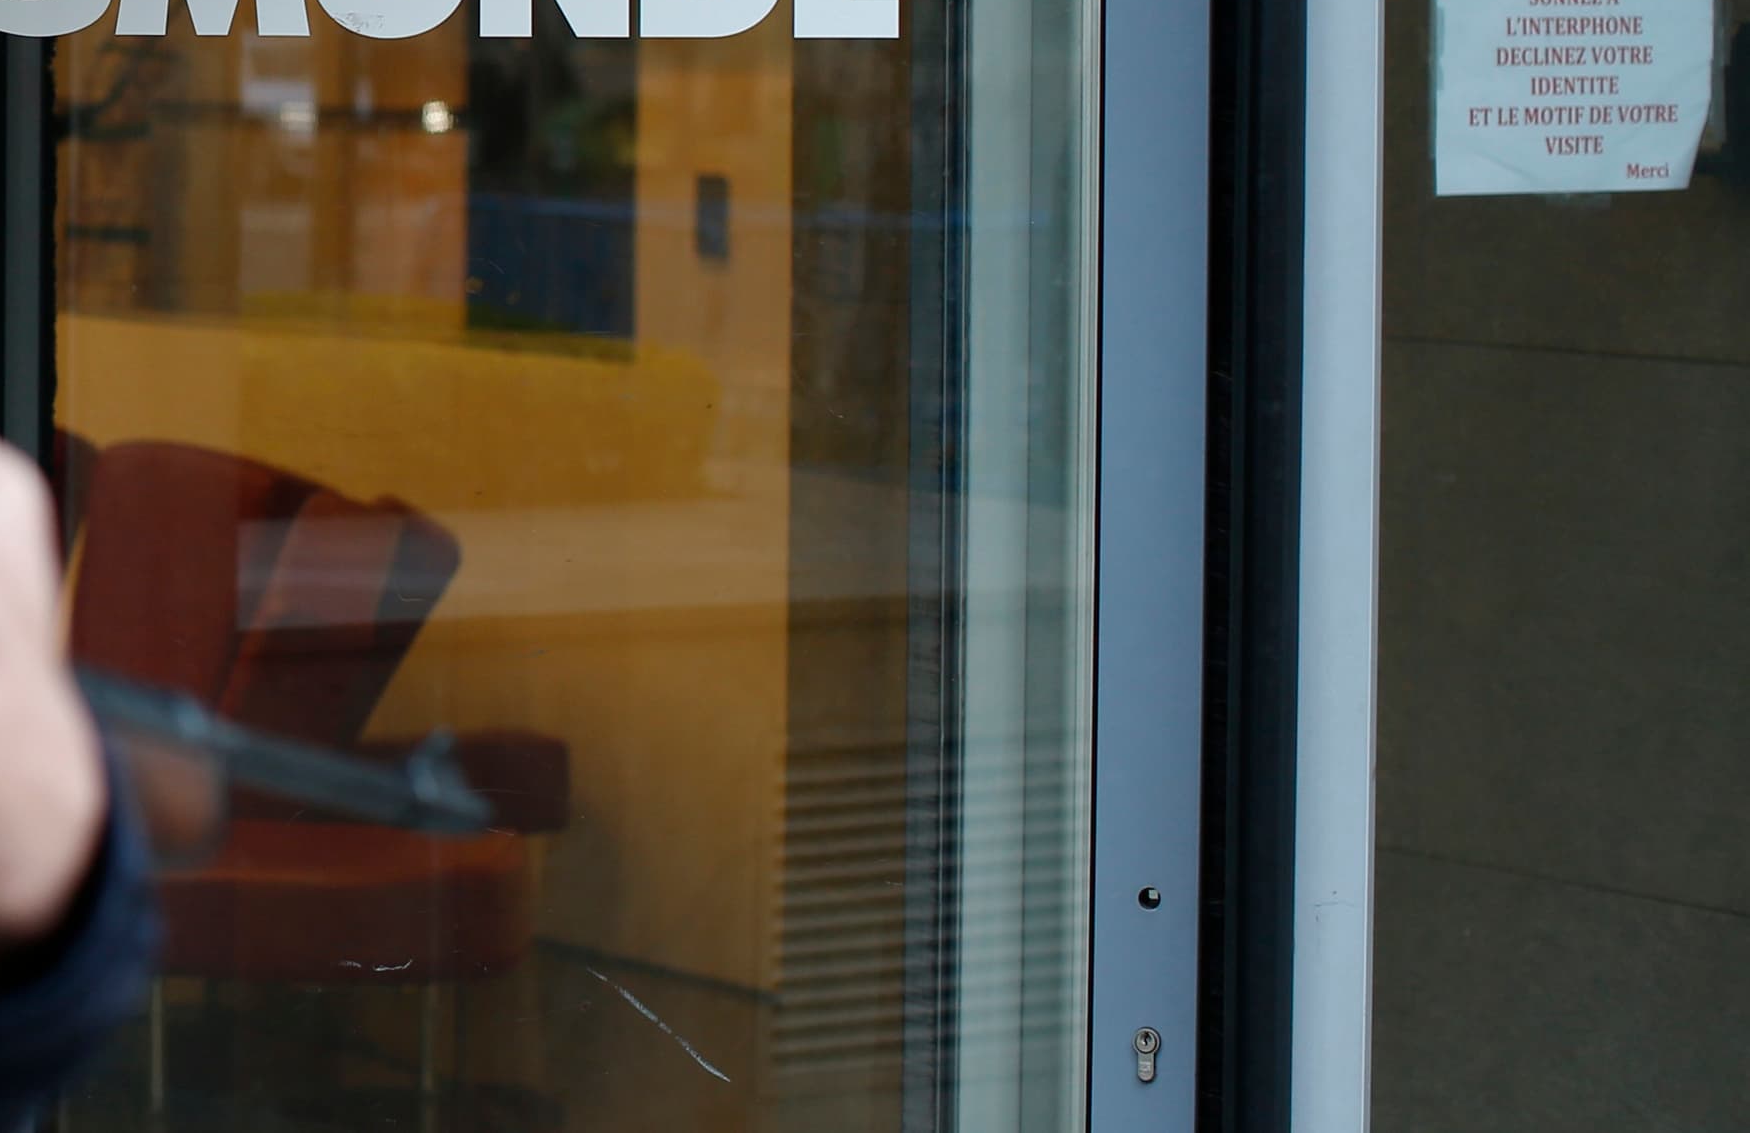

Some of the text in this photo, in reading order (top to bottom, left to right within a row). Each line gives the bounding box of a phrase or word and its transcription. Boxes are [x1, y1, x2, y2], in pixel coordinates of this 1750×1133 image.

[1506, 16, 1643, 36] L'INTERPHONE
[1496, 46, 1653, 67] DECLINEZ VOTRE
[1530, 76, 1620, 96] IDENTITE
[1468, 104, 1679, 127] ET LE MOTIF DE VOTRE
[1545, 135, 1604, 155] VISITE
[1626, 163, 1670, 179] Merci
